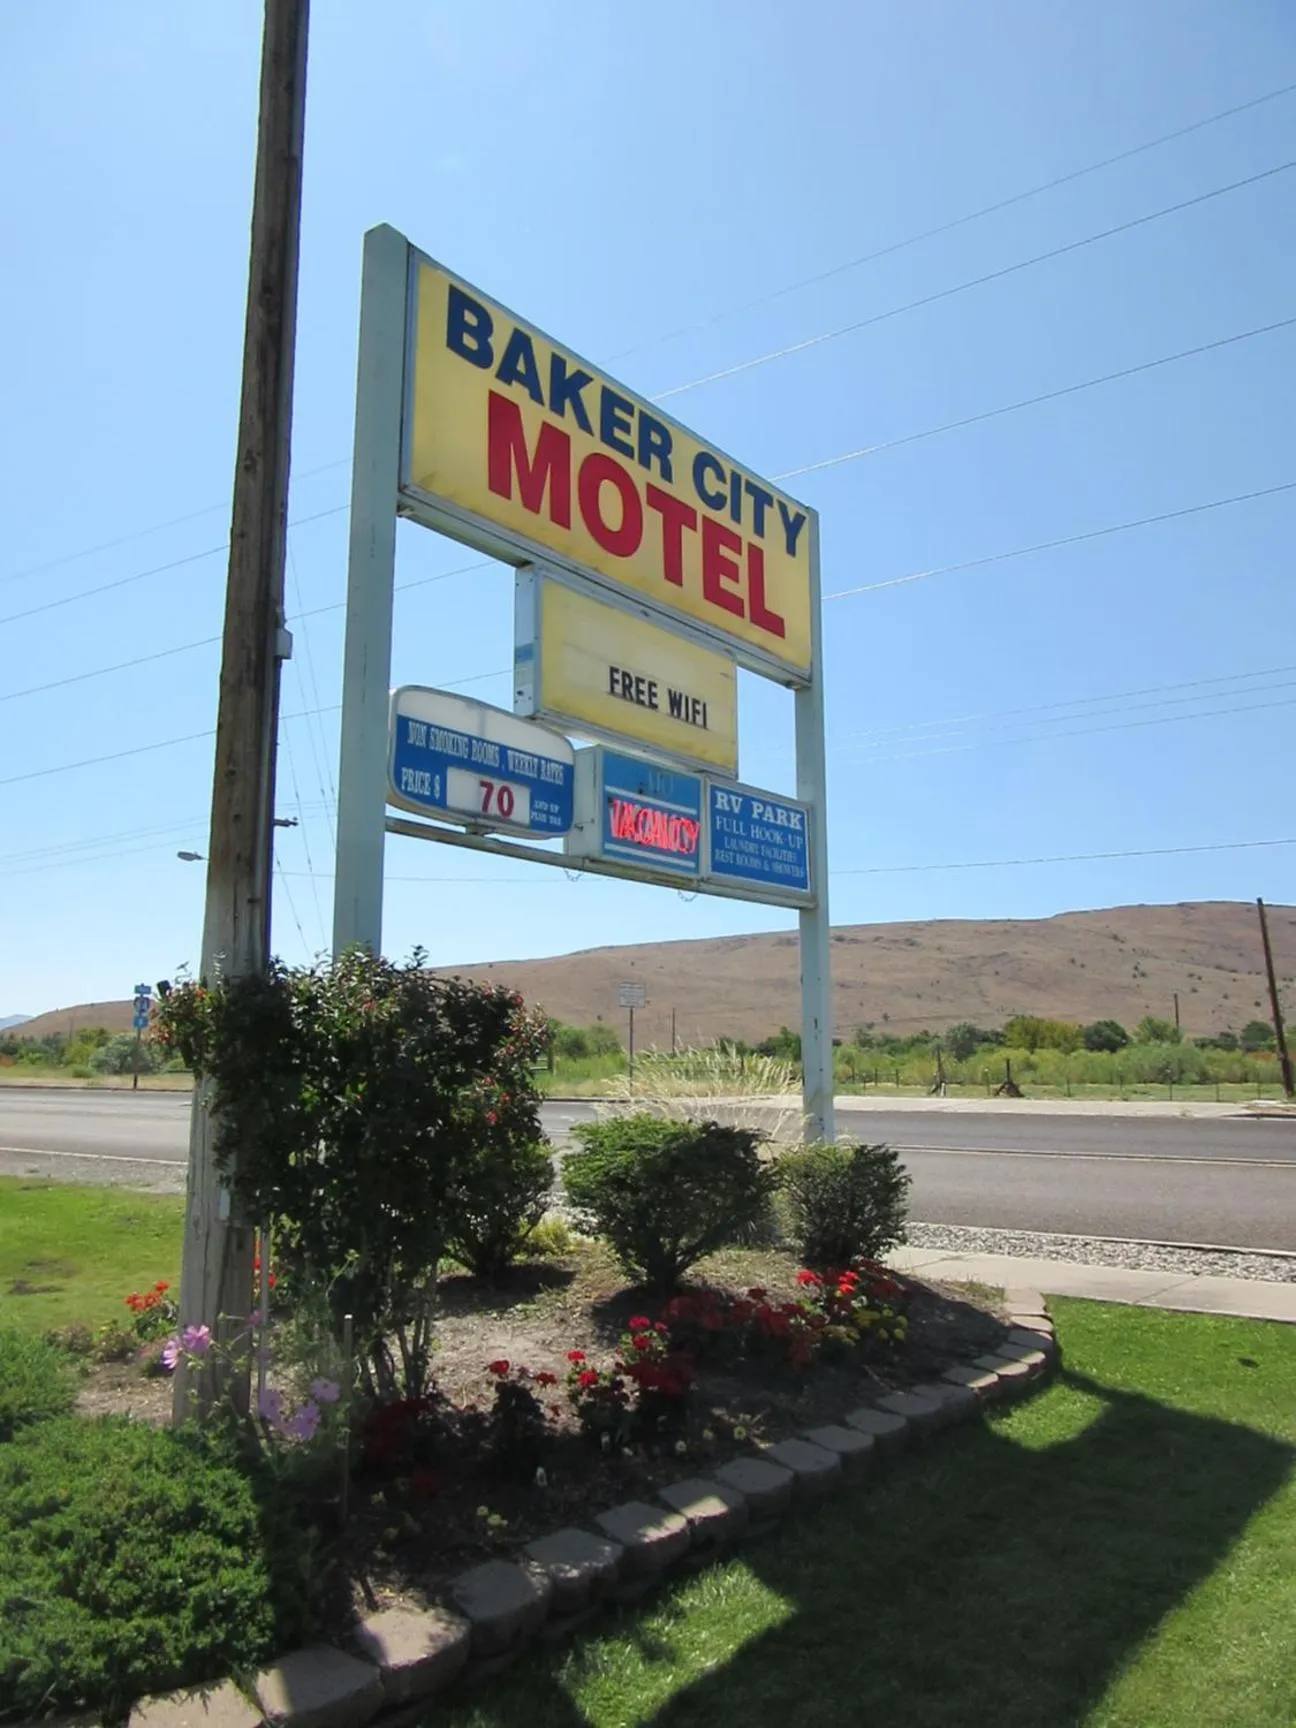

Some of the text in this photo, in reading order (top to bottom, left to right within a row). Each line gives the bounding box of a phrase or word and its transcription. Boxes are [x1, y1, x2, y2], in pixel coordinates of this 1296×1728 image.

[446, 284, 806, 557] BAKER CITY
[488, 389, 785, 639] MOTEL
[609, 666, 707, 730] FREE WIFI
[408, 721, 427, 748] NON
[429, 728, 469, 759] SMOKING
[507, 749, 538, 779] WEEKLY
[540, 759, 564, 785] RATES
[401, 767, 514, 818] PRICE $ 70
[715, 790, 803, 830] RV PARK
[610, 799, 701, 854] VACANCY
[715, 815, 746, 836] FULL
